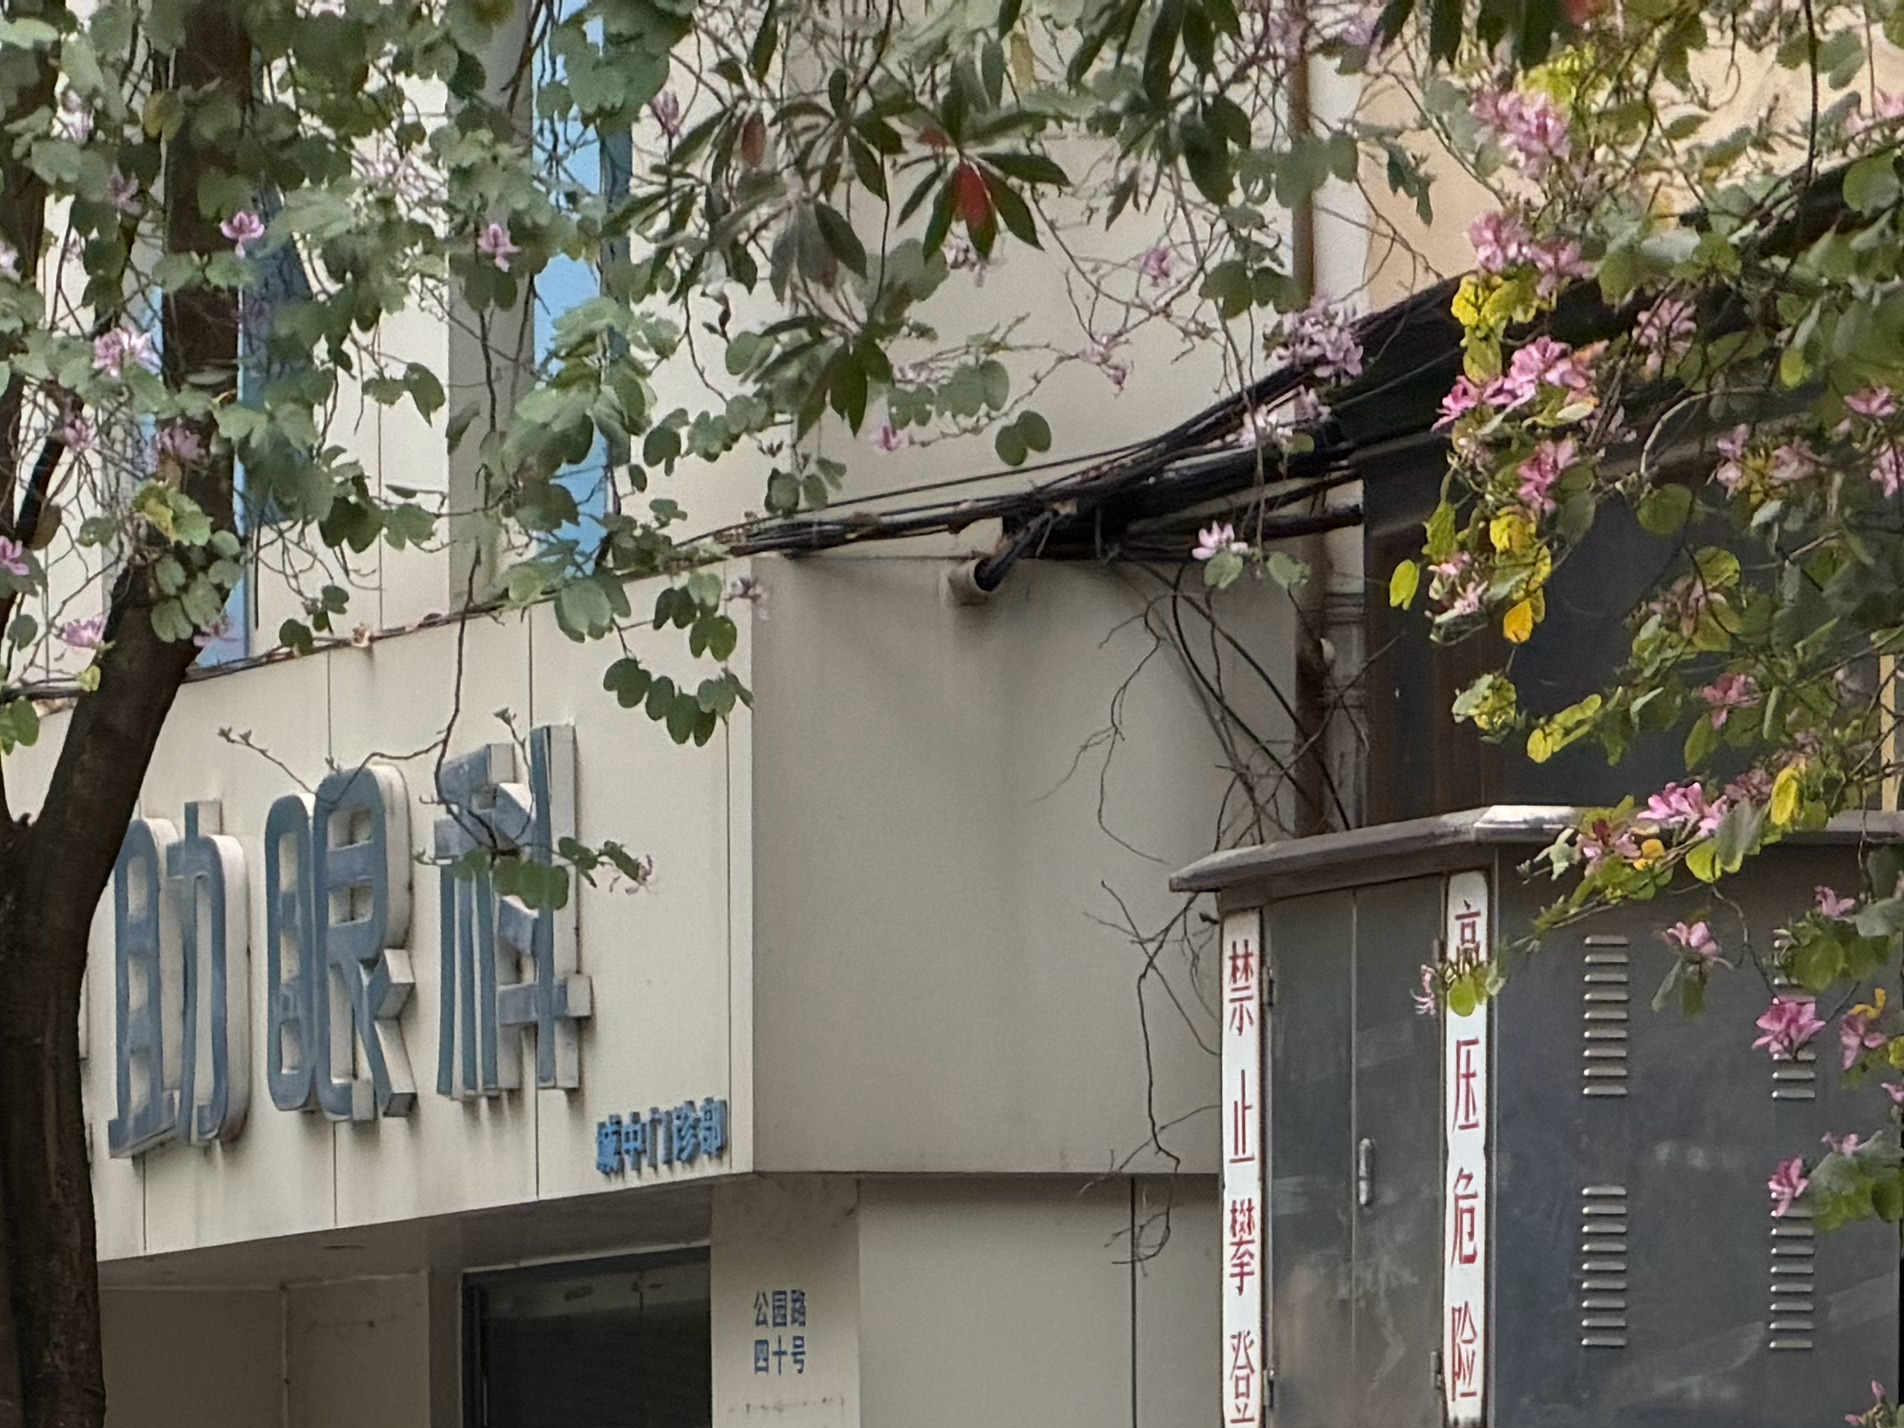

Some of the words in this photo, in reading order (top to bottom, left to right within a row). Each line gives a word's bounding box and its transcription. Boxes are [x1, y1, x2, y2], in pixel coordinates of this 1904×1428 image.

[1227, 939, 1256, 1426] 禁止攀登
[1450, 899, 1482, 1401] 高压危险
[752, 1289, 807, 1328] 公园路
[753, 1333, 807, 1377] 四十号
